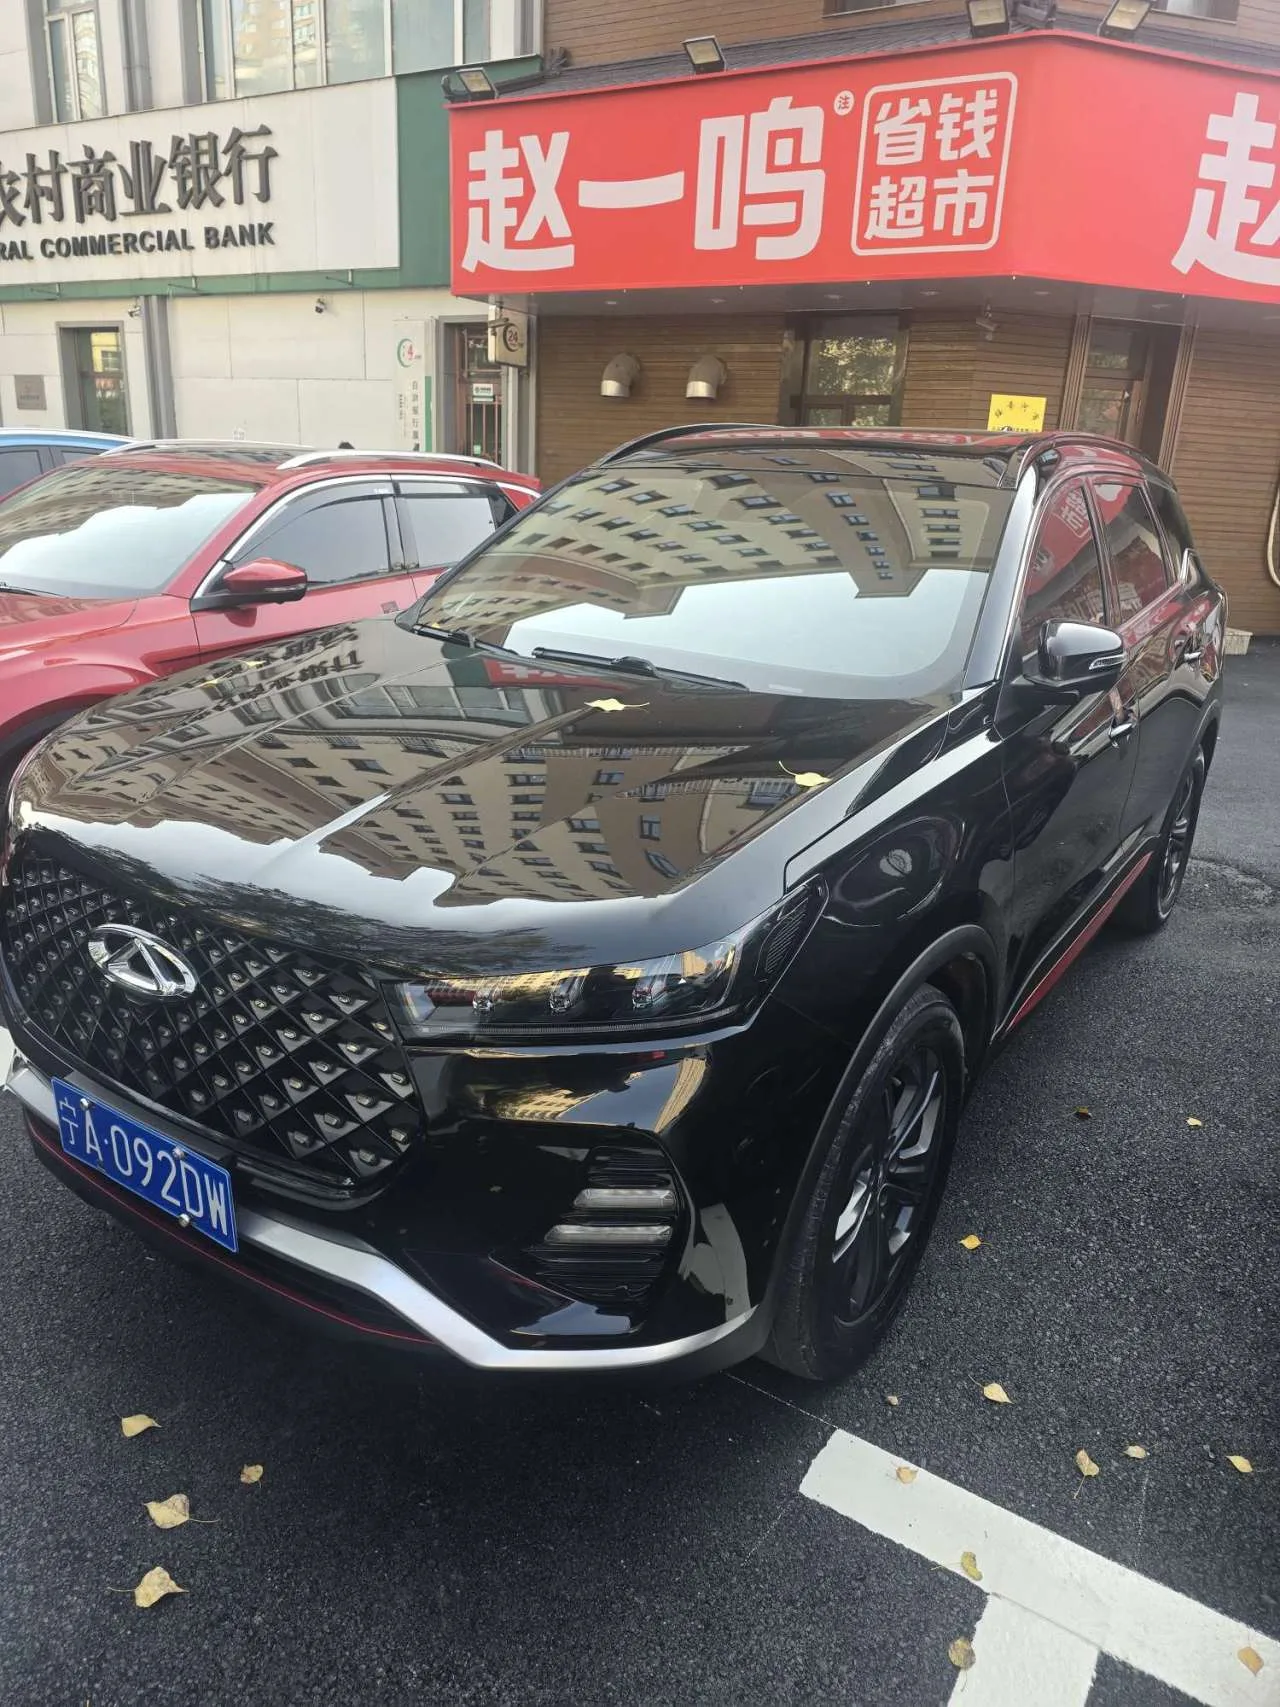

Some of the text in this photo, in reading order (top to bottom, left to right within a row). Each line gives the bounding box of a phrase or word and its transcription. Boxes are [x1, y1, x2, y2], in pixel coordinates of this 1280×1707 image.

[873, 89, 998, 166] 省钱
[461, 96, 825, 272] 赵一鸣
[864, 168, 995, 240] 超市
[40, 228, 195, 259] COMMERCIAL
[204, 222, 275, 249] BANK
